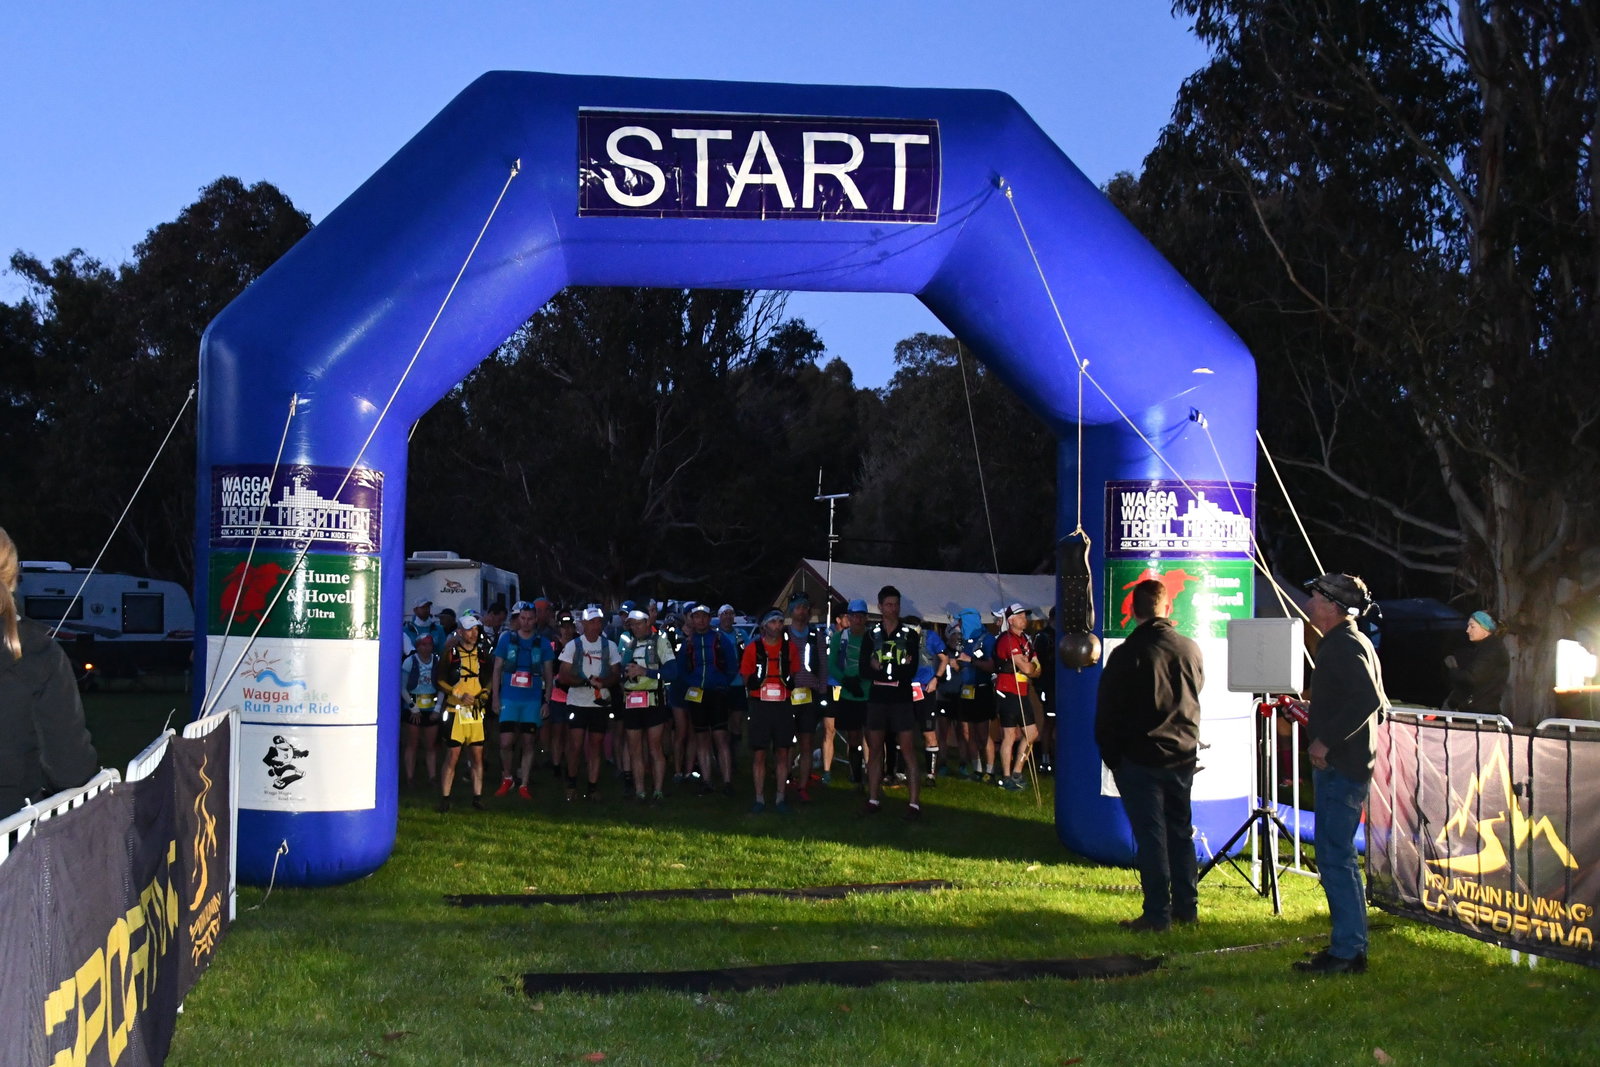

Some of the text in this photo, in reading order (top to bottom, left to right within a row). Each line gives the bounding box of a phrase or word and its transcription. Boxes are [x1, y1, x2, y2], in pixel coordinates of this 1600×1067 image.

[605, 125, 930, 211] START
[222, 476, 272, 492] WAGGA
[221, 491, 271, 507] WAGGA
[1120, 490, 1179, 507] WAGGA
[221, 506, 370, 531] TRAIL MARATHON
[1120, 505, 1178, 521] WAGGA
[330, 531, 346, 539] KIDS
[1120, 519, 1179, 538] TRAIL
[302, 569, 350, 584] Hume
[307, 608, 336, 619] Ultra
[242, 687, 289, 703] Wagga
[244, 700, 340, 714] Run and Ride
[1424, 868, 1502, 907] MOUNTAIN
[1456, 901, 1593, 951] SPORTIVA
